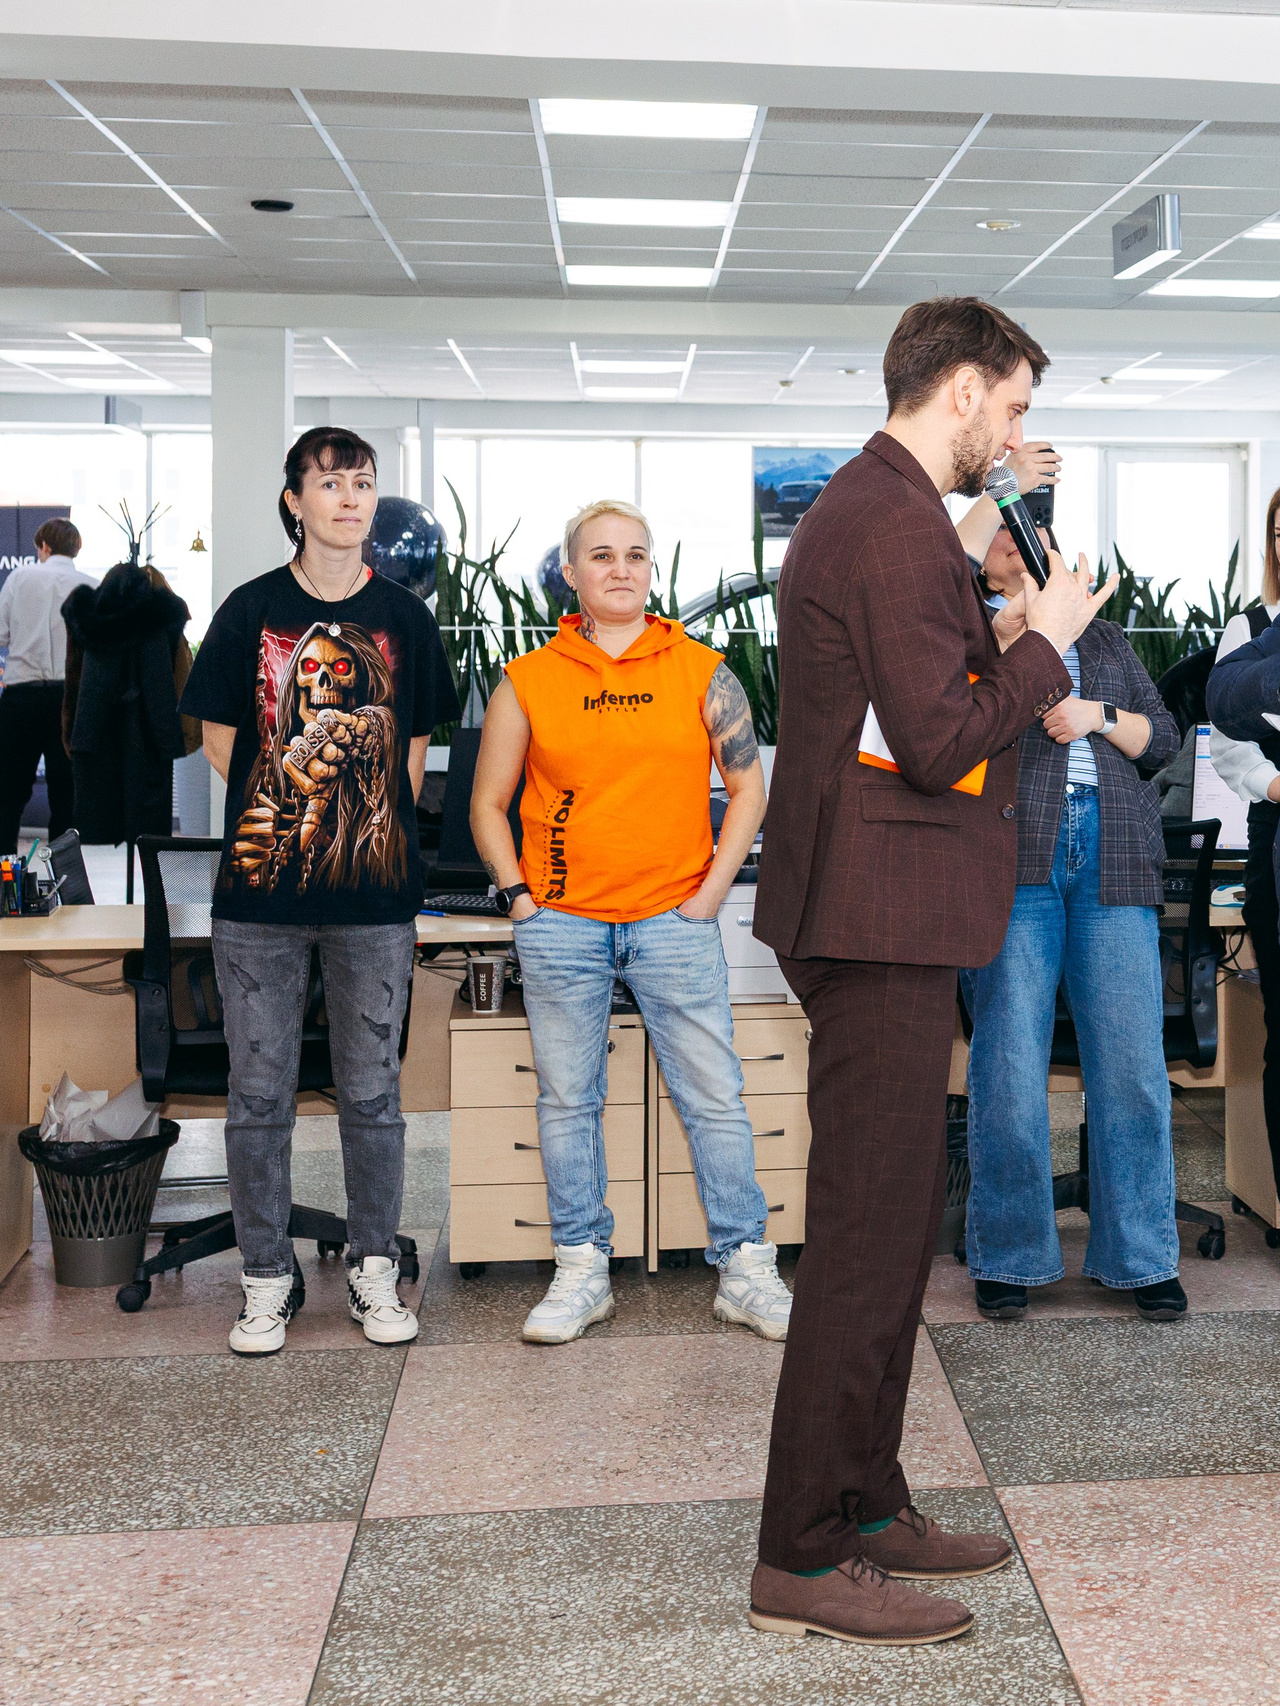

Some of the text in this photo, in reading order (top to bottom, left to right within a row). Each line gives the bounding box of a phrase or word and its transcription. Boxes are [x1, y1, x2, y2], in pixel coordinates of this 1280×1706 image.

[584, 690, 653, 710] Inferno
[599, 706, 637, 714] STYLE
[290, 728, 326, 764] BOSS
[553, 789, 575, 824] NO
